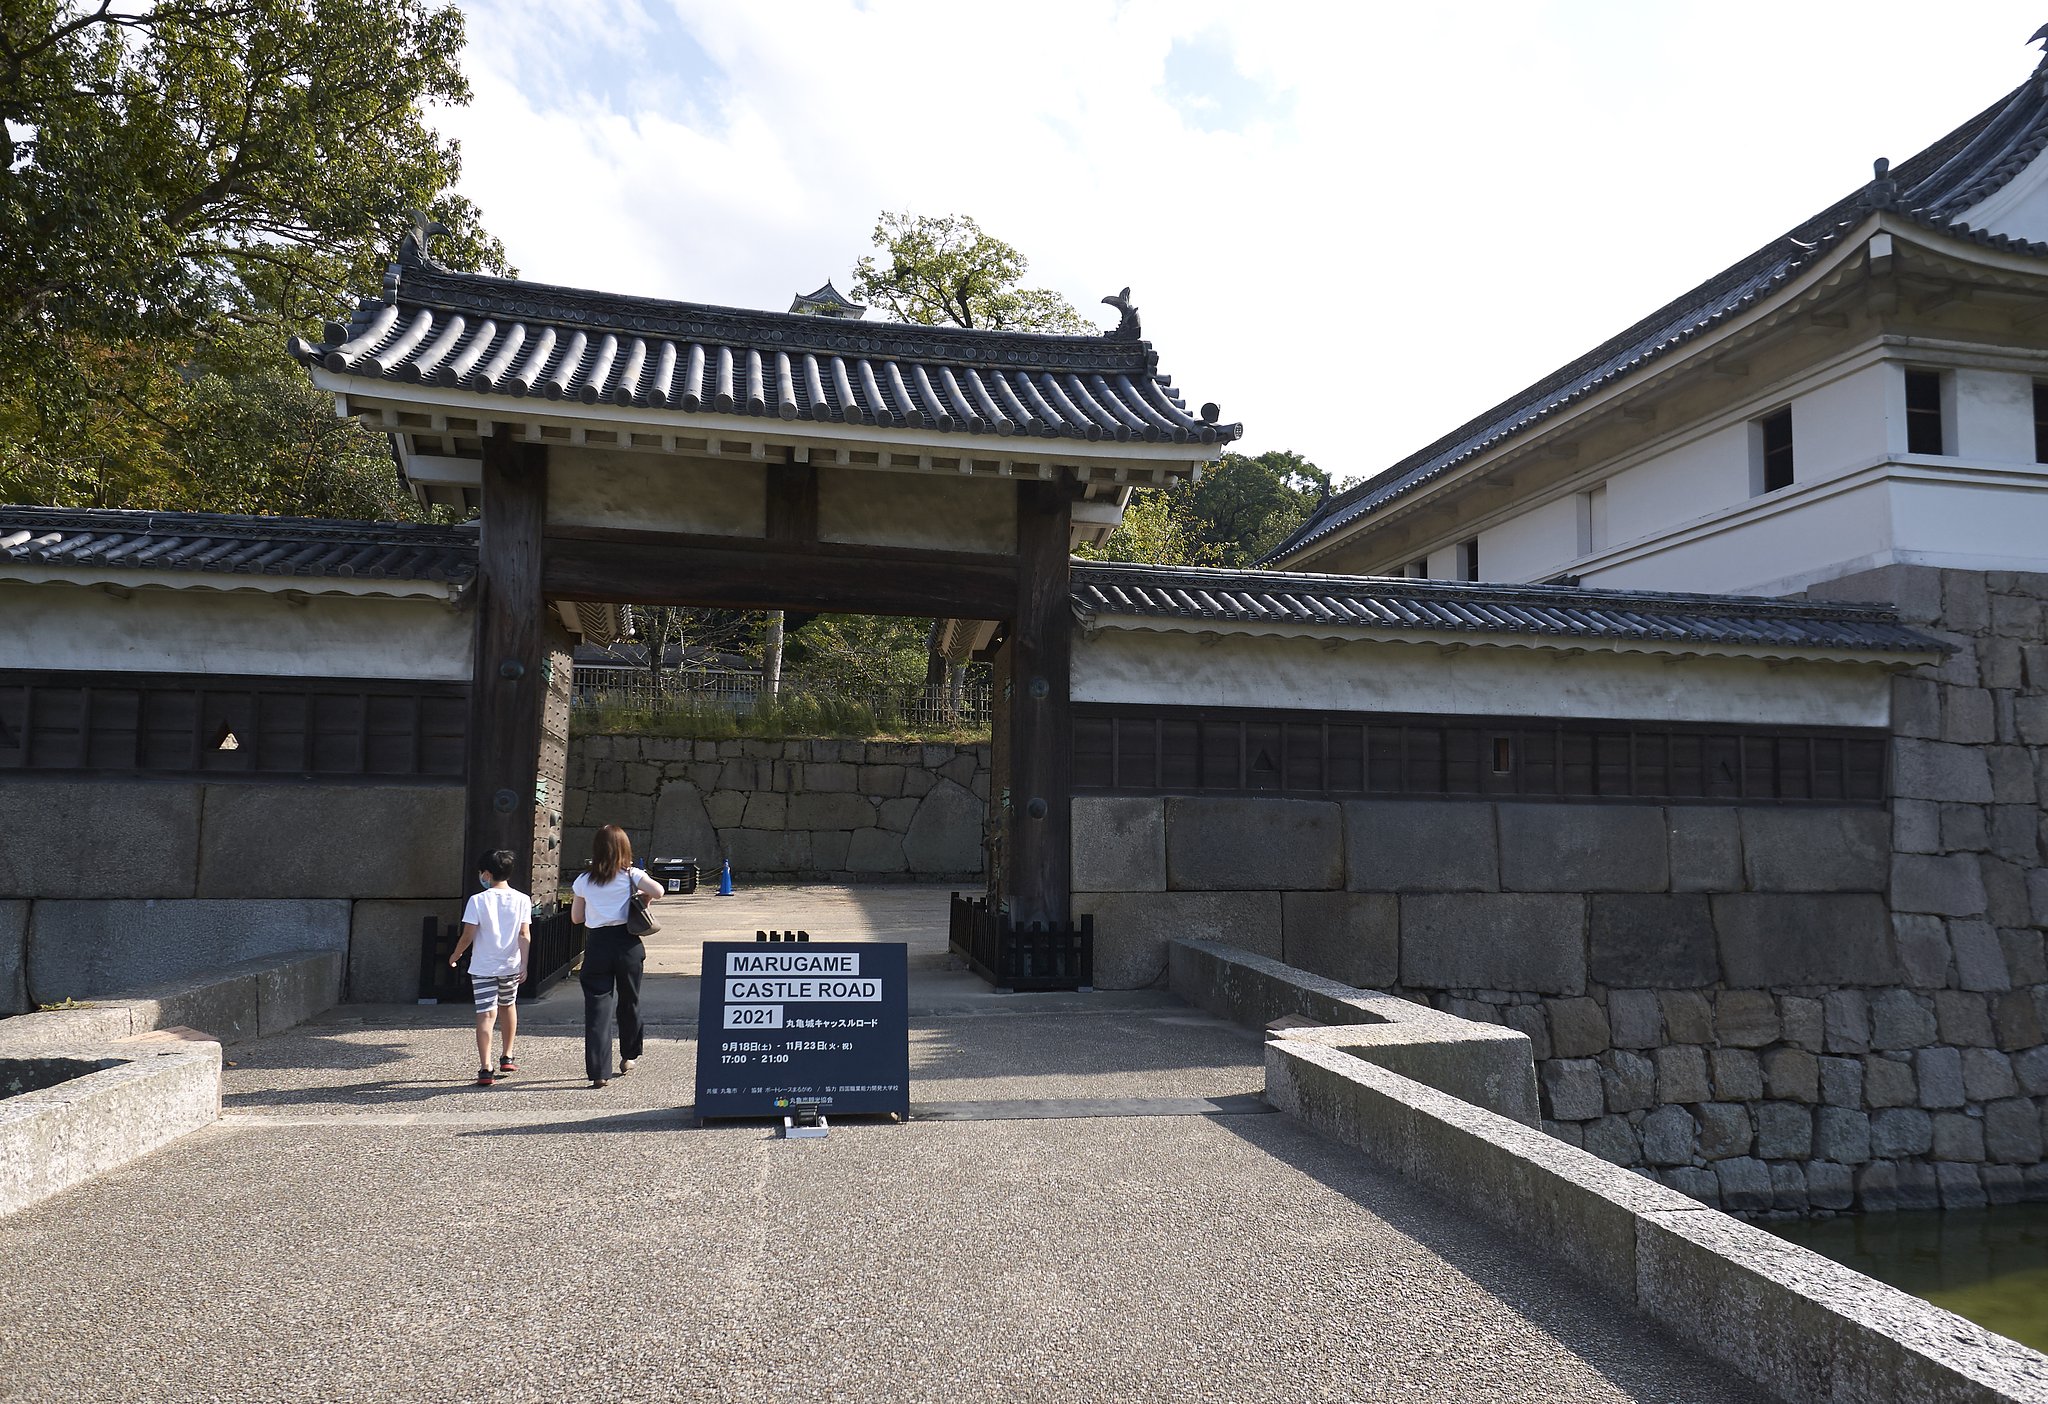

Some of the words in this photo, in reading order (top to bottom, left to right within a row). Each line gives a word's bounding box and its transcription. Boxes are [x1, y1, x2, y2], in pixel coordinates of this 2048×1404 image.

[733, 956, 852, 972] MARUGAME
[731, 982, 812, 998] CASTLE
[818, 982, 876, 998] ROAD
[731, 1009, 774, 1025] 2021
[785, 1018, 878, 1029] 丸亀城キャッスルロード
[721, 1054, 747, 1064] 17:00
[761, 1054, 789, 1064] 21:00
